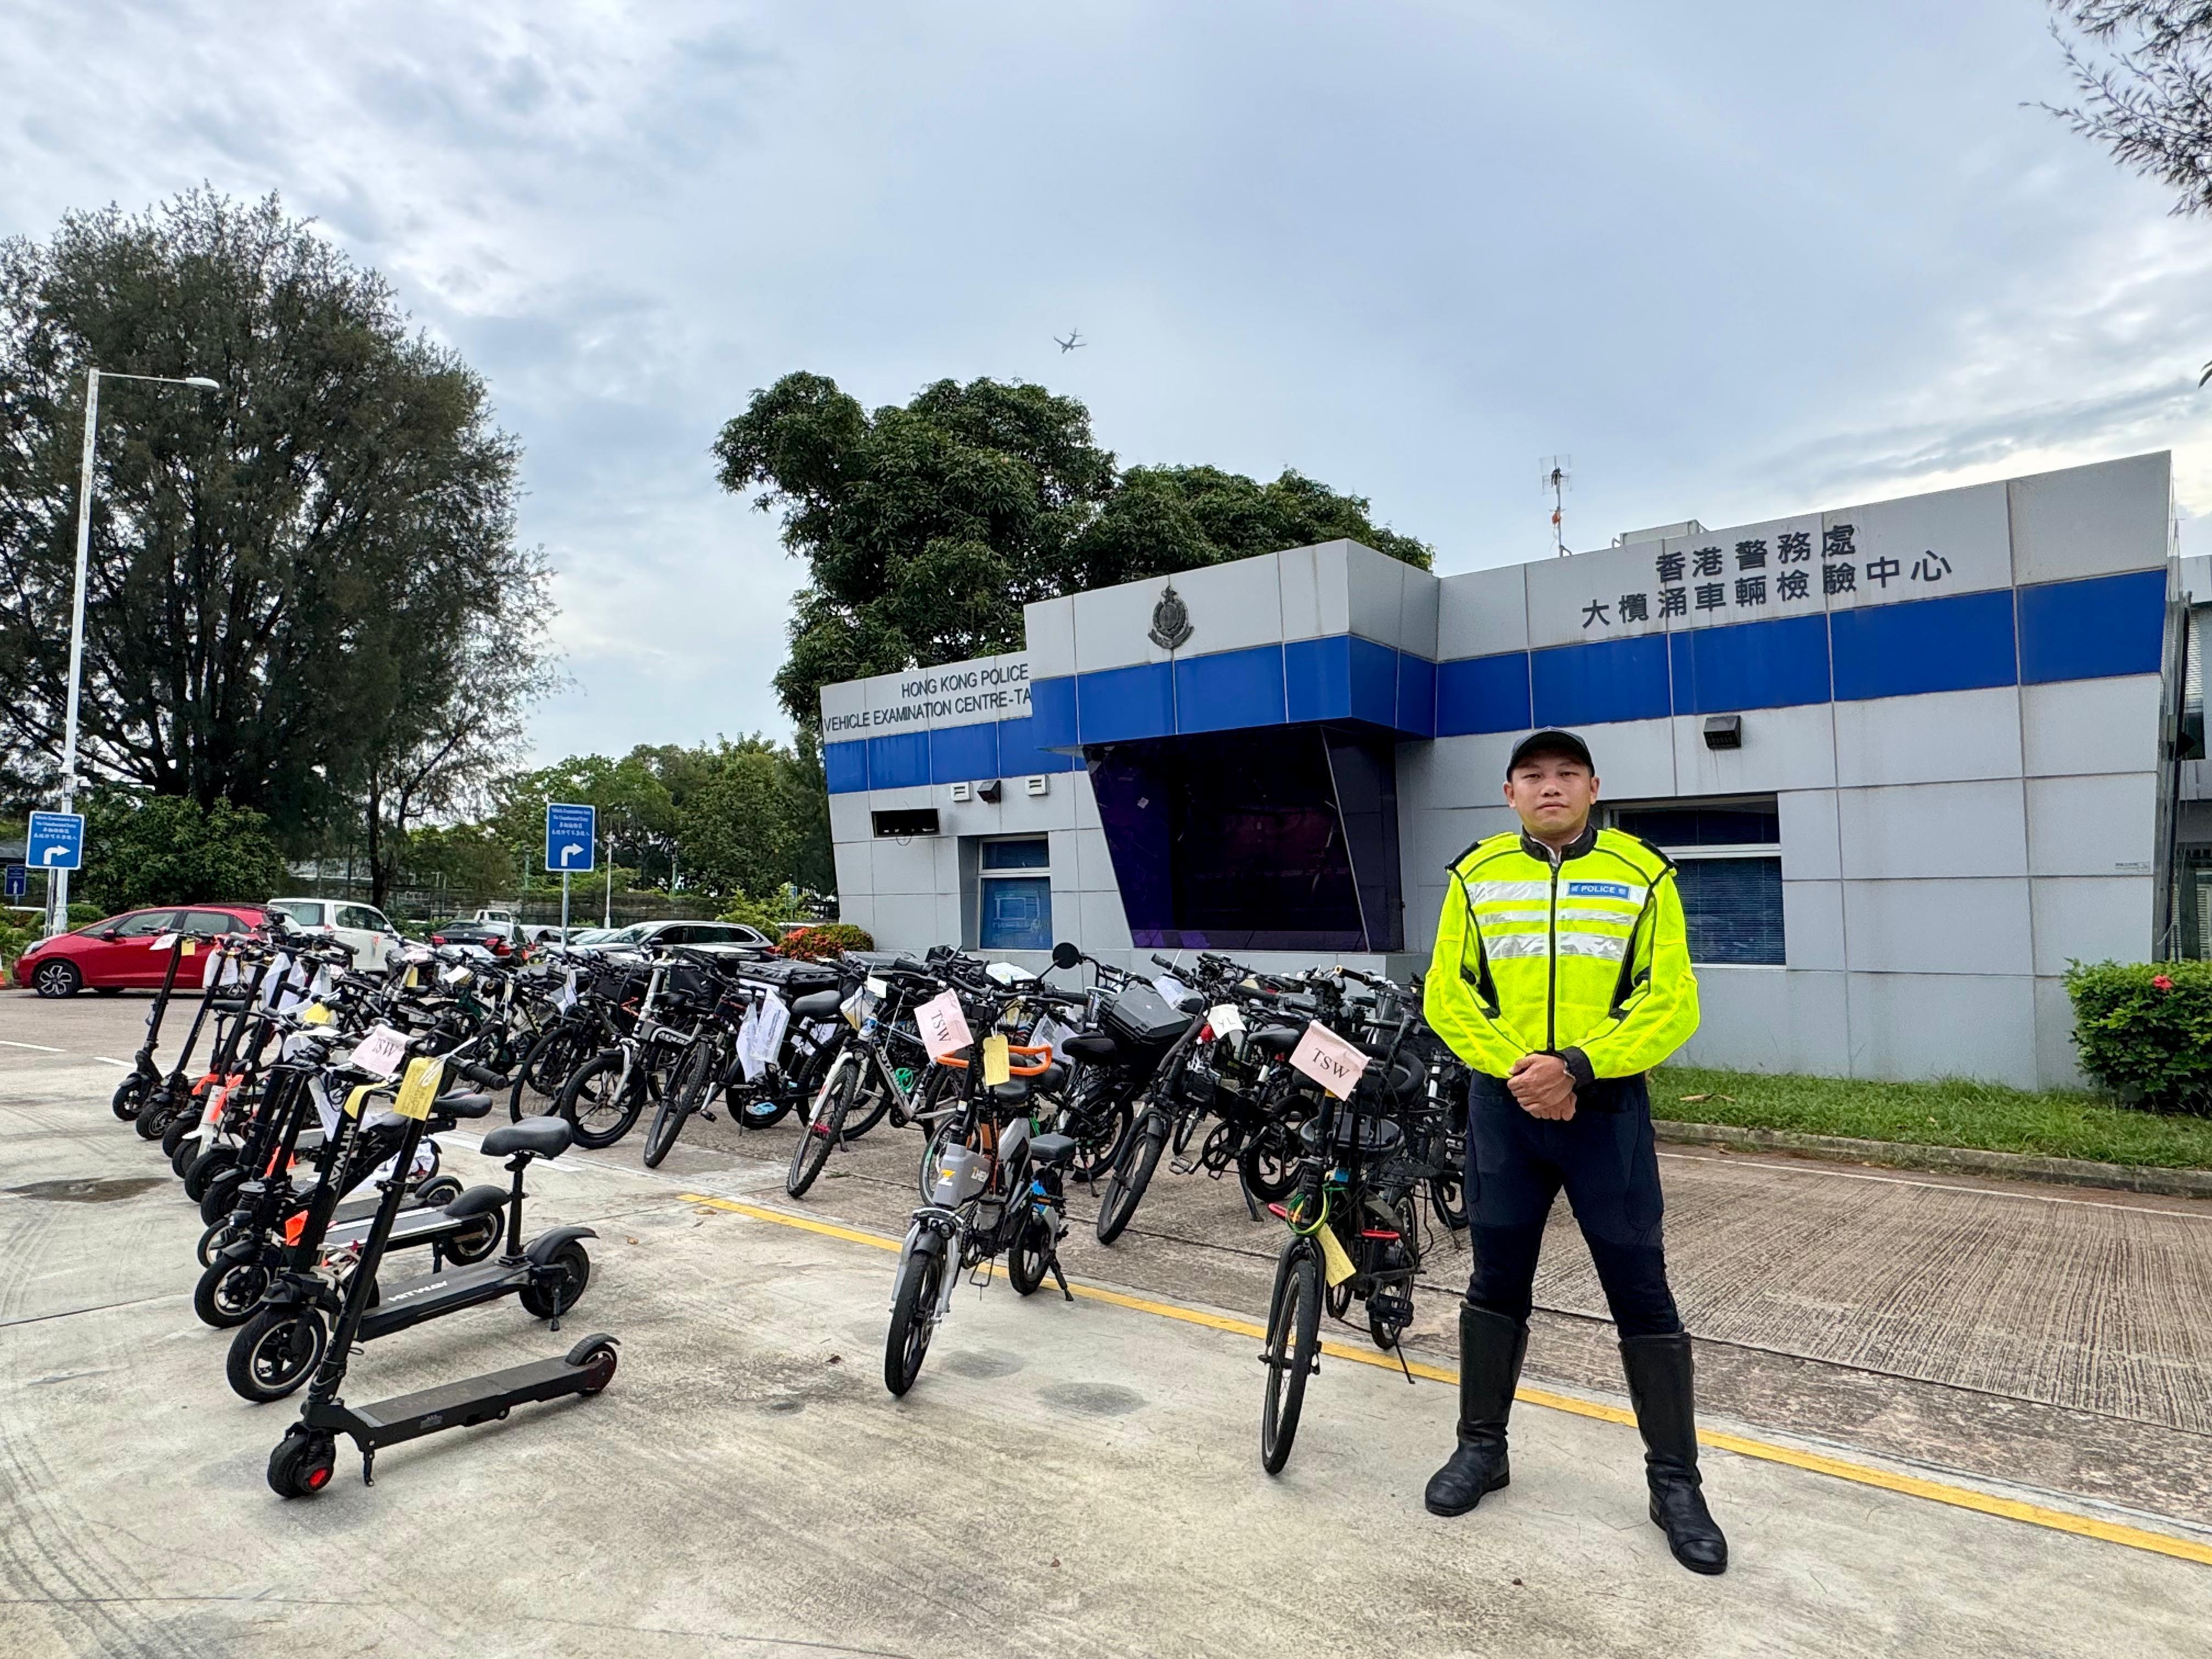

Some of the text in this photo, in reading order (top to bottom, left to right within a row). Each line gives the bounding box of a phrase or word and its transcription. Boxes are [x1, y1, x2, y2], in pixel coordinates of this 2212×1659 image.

[1656, 525, 1855, 583] 香港警務處
[1582, 550, 1953, 629] 大欖涌車輛檢驗中心
[901, 663, 1029, 698] HONG KONG POLICE
[824, 712, 870, 732] VEHICLE
[874, 700, 952, 725] EXAMINATION
[1581, 885, 1616, 893] POLICE
[931, 1009, 951, 1041] TSW
[372, 1037, 396, 1058] TSW
[1312, 1047, 1350, 1079] TSW
[327, 1122, 358, 1192] HITWAY
